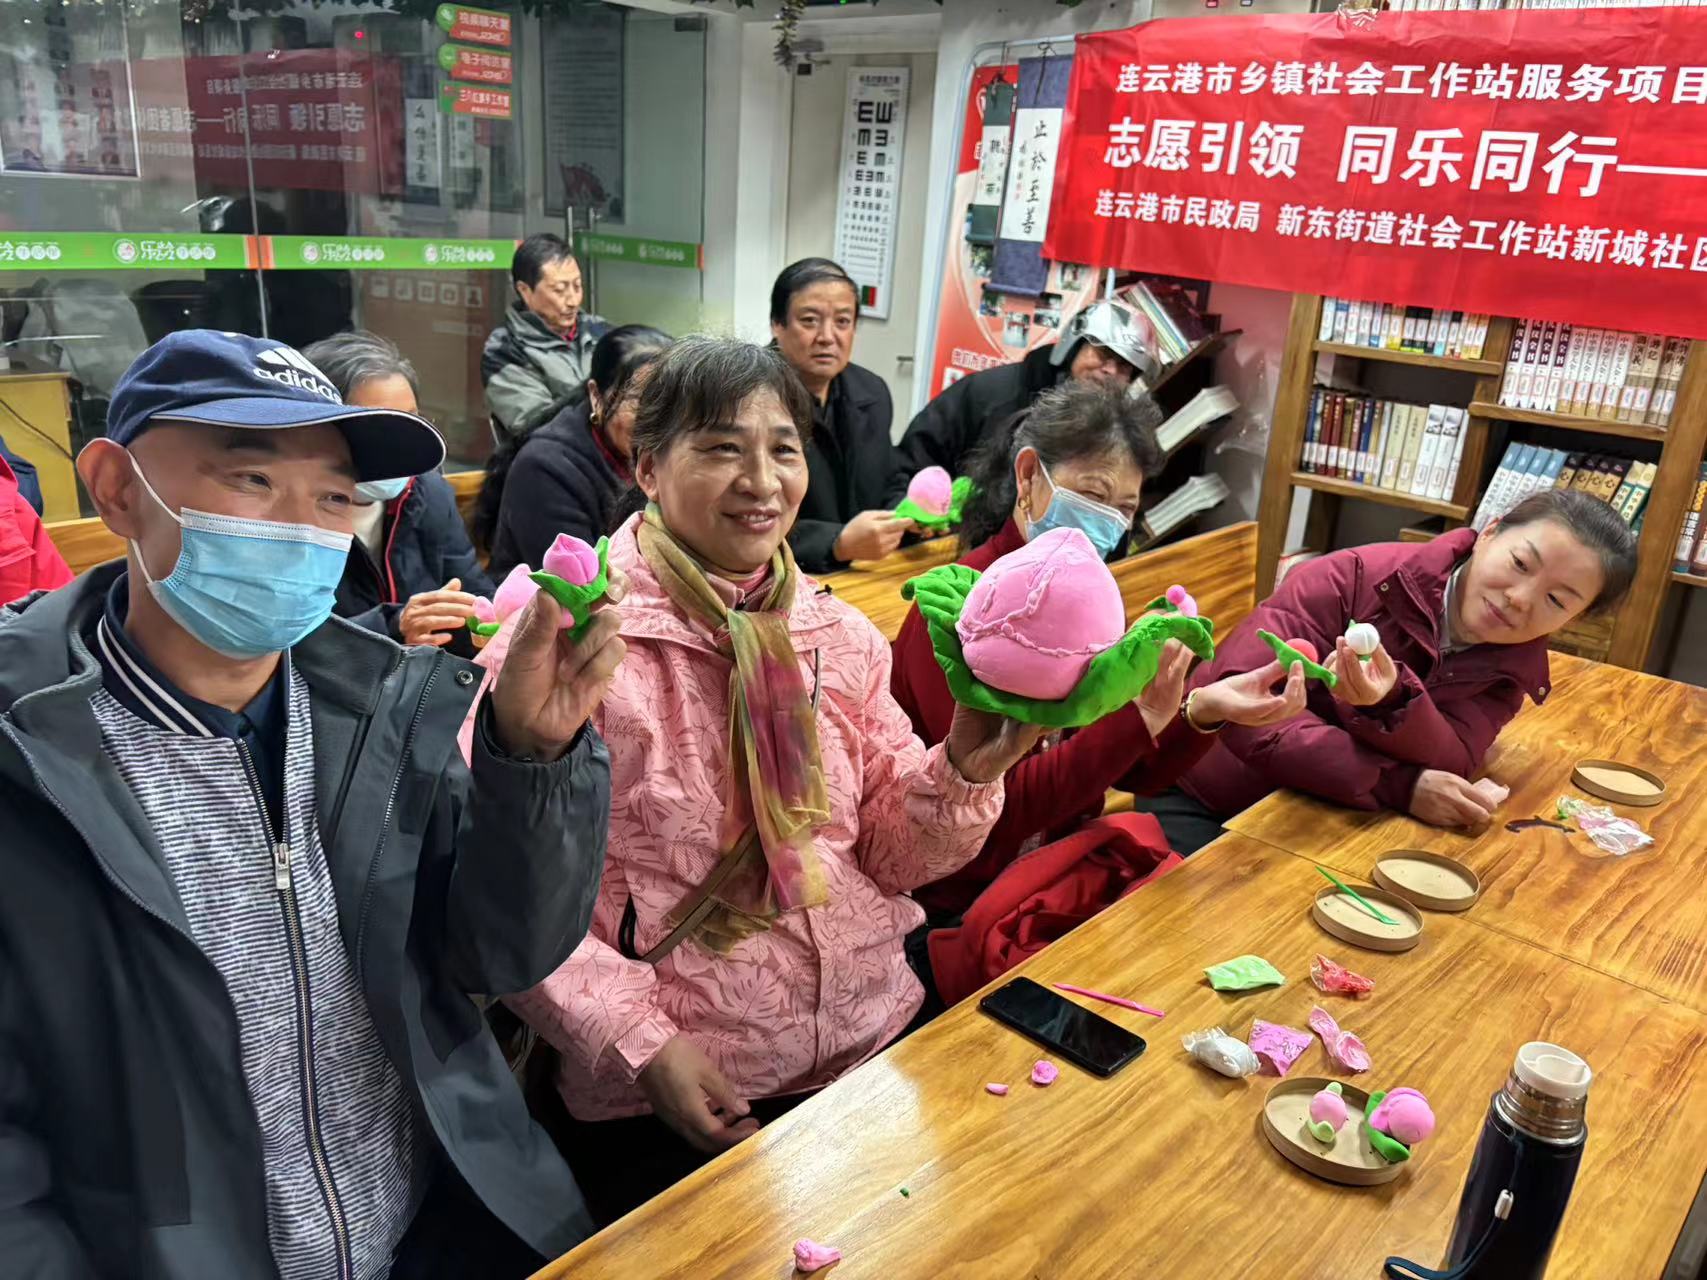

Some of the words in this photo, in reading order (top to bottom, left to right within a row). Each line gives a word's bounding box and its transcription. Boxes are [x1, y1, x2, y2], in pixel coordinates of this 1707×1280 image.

[1116, 61, 1707, 106] 连云港市乡镇社会工作站服务项目
[1104, 115, 1305, 180] 志愿引领
[1095, 190, 1261, 234] 连云港市民政局
[253, 367, 343, 405] adidas
